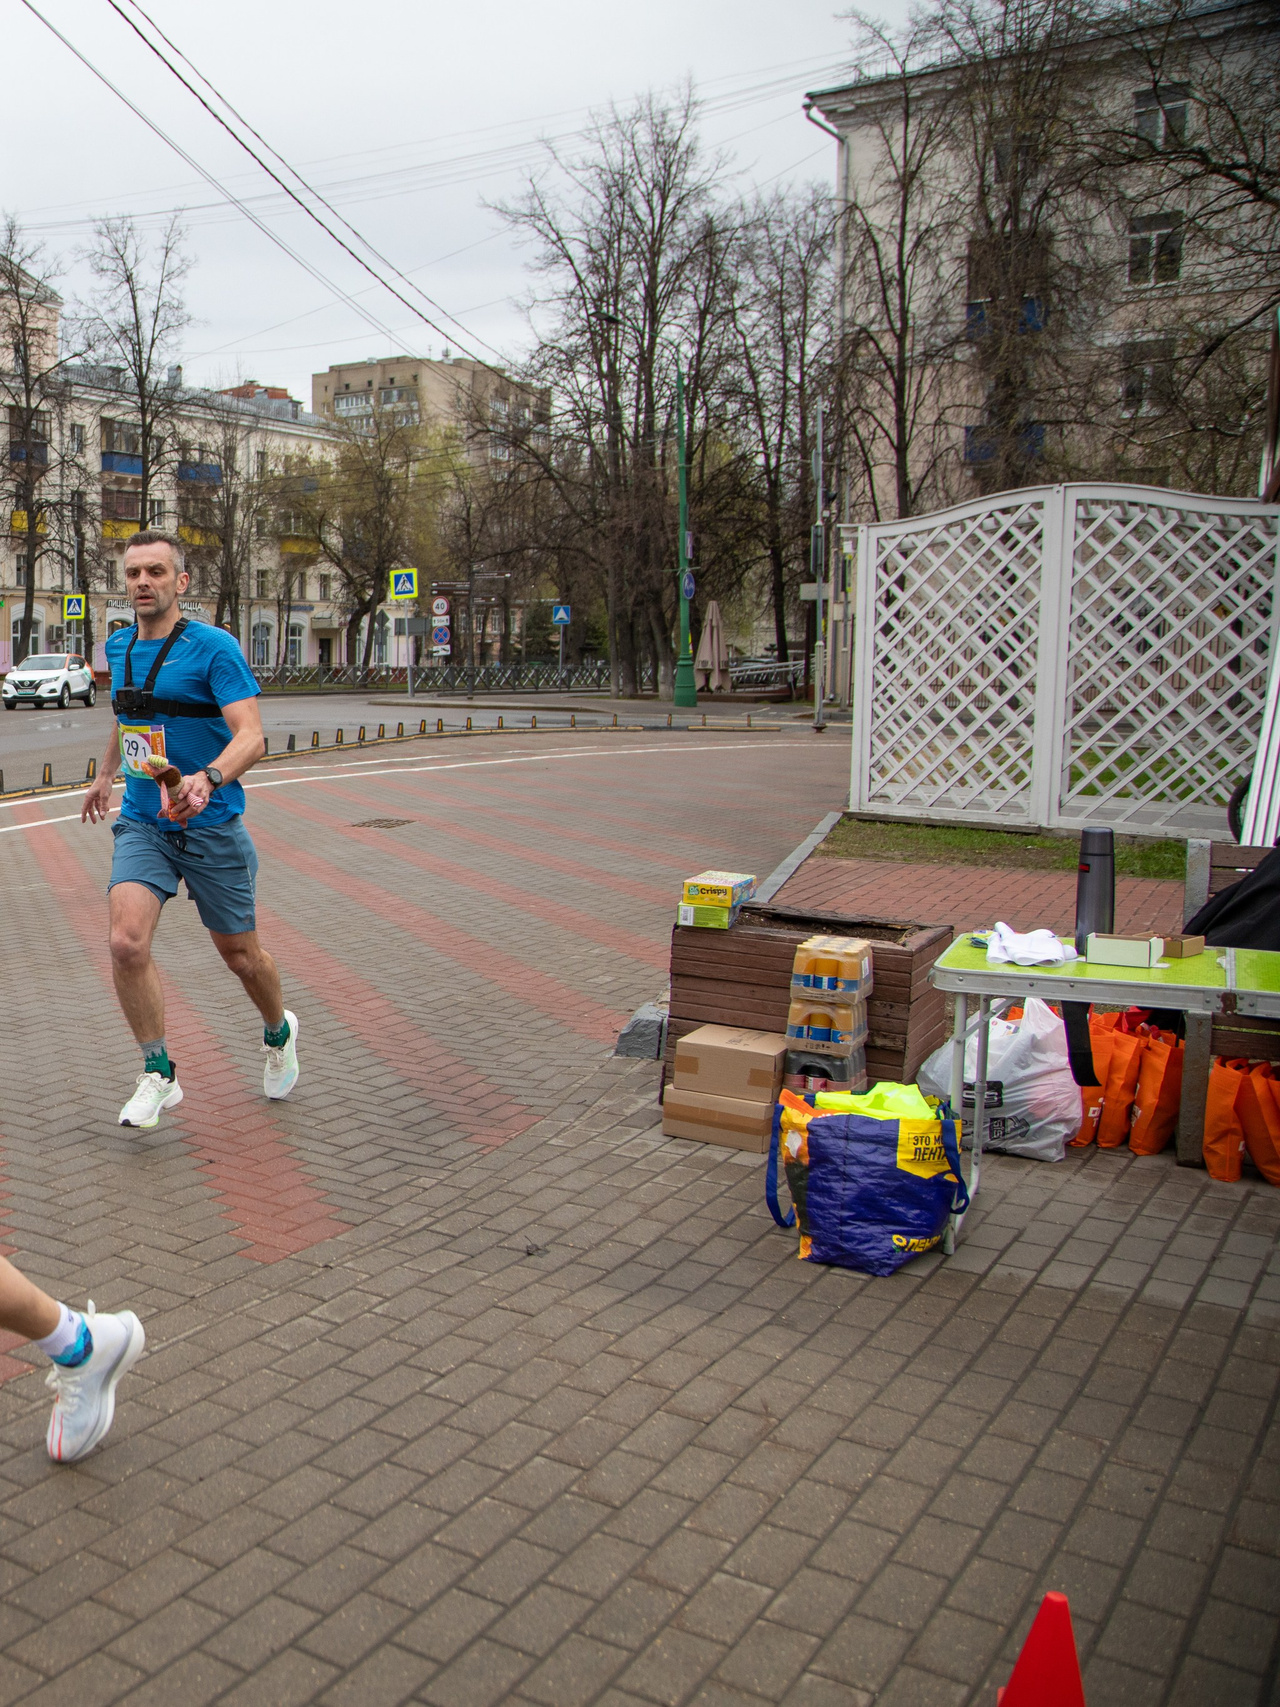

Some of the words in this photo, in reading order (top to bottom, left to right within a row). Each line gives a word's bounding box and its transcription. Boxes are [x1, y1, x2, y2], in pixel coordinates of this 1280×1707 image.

[108, 599, 132, 609] ПИЦЦЕР
[435, 602, 445, 610] 40
[125, 739, 139, 757] 29
[142, 746, 147, 758] 1
[700, 887, 727, 896] Crispy
[913, 1135, 930, 1146] ЭТО
